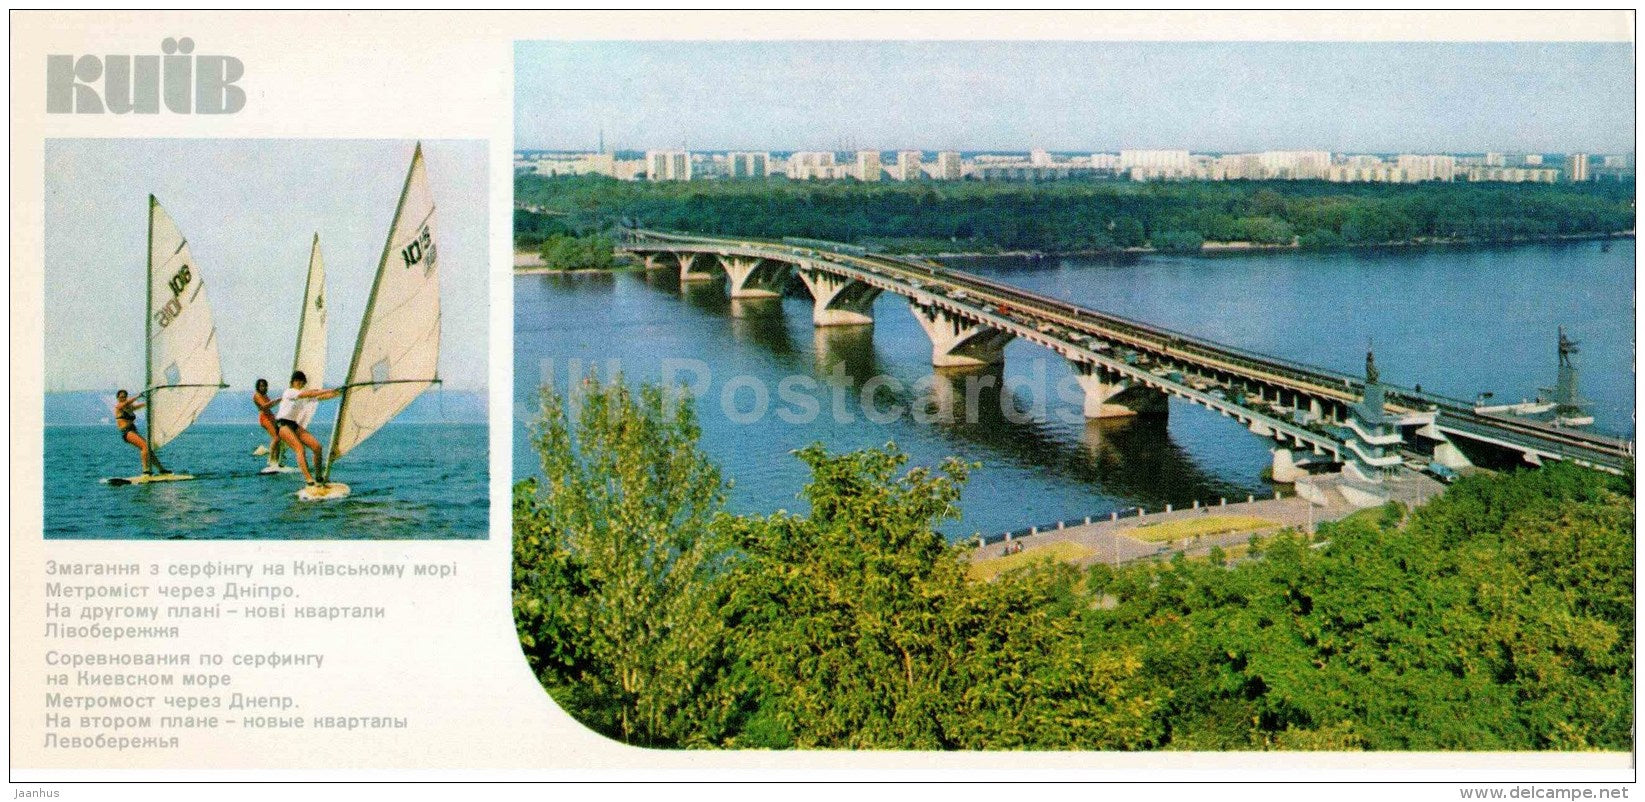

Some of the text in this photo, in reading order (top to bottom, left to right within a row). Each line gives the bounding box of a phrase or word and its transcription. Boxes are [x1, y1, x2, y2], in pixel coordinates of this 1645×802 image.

[46, 560, 457, 579] Змагання з серфінгу на Київському морі
[46, 583, 299, 601] Метроміст через Дніпро.
[46, 603, 70, 618] На
[81, 606, 158, 621] другому
[168, 603, 220, 618] плані
[246, 603, 285, 618] нові
[295, 606, 385, 621] квартали
[45, 623, 179, 640] Лівобережжя
[46, 651, 323, 669] Соревнования по серфингу
[47, 671, 231, 688] на Киевском море
[46, 693, 299, 710] Метромост через Днепр.
[46, 713, 70, 728] На
[80, 716, 151, 731] втором
[161, 716, 219, 728] плане
[244, 716, 304, 728] новые
[314, 716, 408, 731] кварталы
[44, 733, 179, 751] Левобережья
